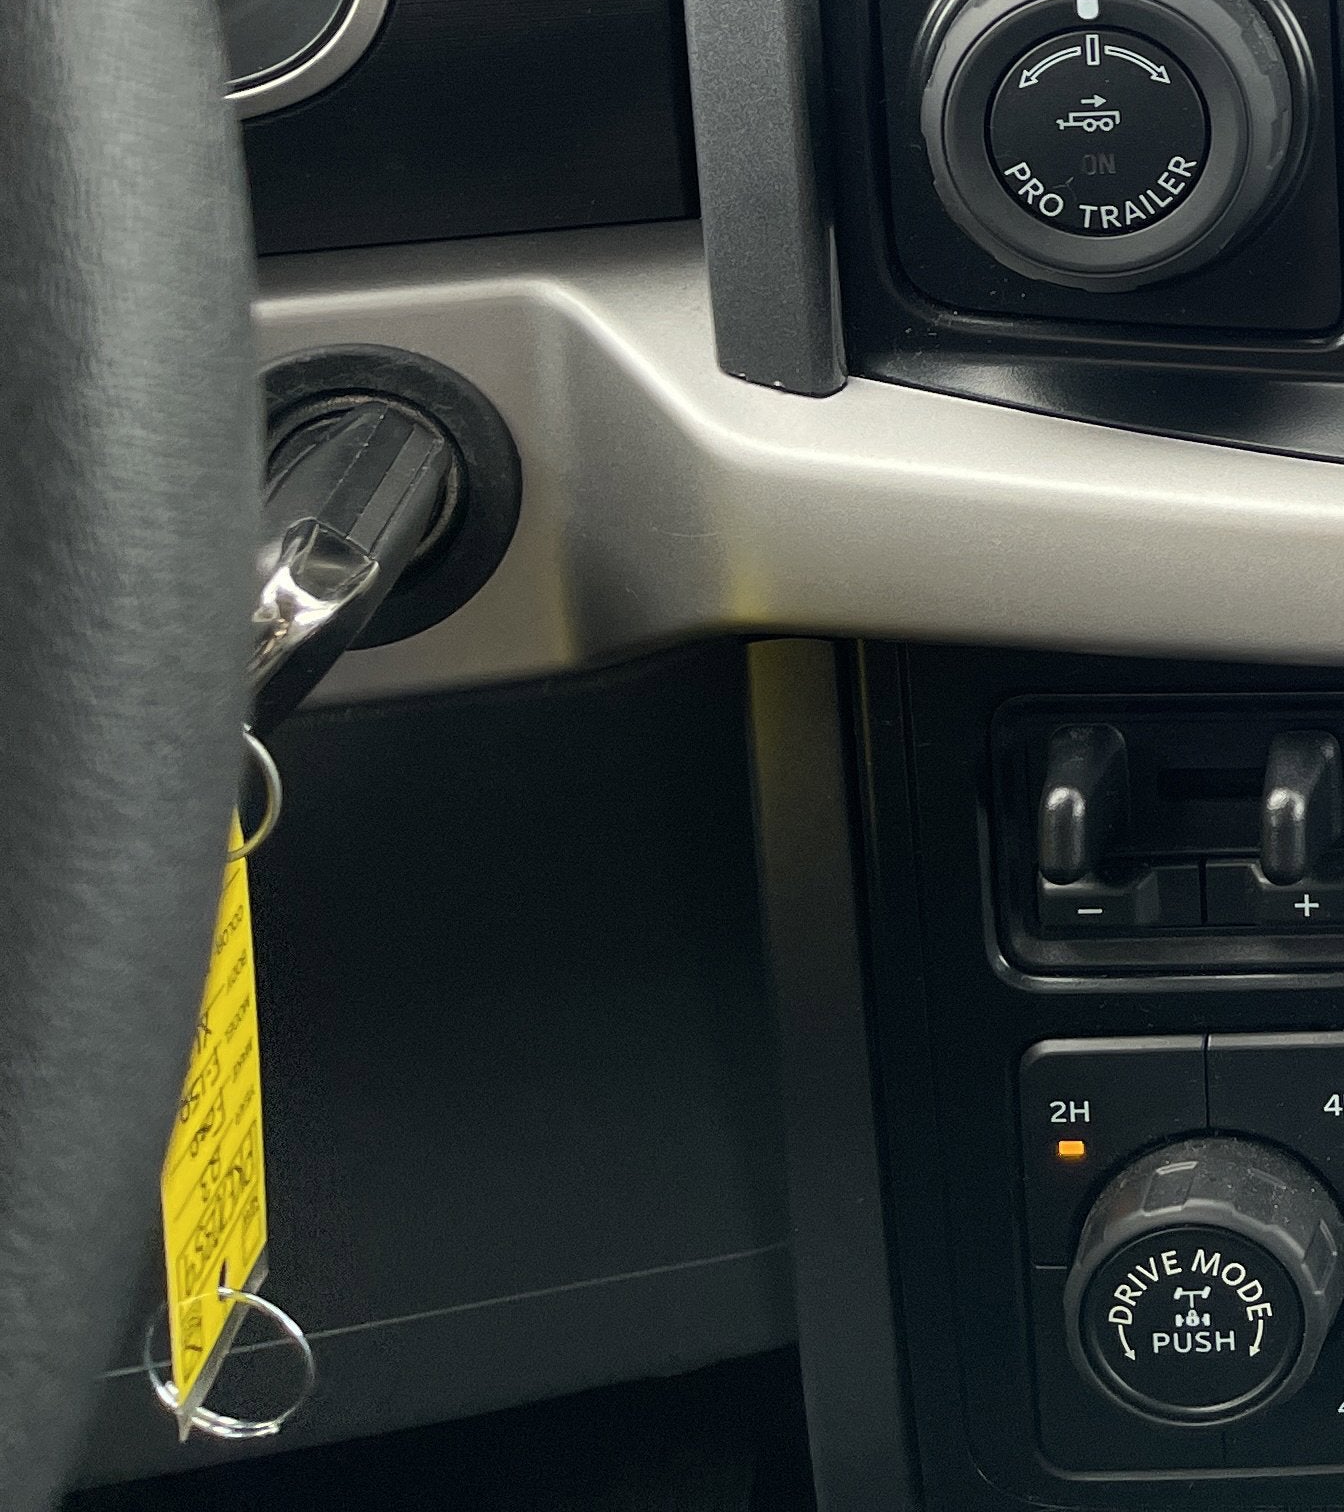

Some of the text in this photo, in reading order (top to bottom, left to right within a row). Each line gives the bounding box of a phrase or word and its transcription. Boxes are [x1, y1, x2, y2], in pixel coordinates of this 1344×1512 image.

[1004, 154, 1198, 229] PRO TRAILER
[1049, 1100, 1091, 1123] 2H
[1108, 1248, 1273, 1326] DRIVE MODE
[1151, 1330, 1236, 1354] PUSH
